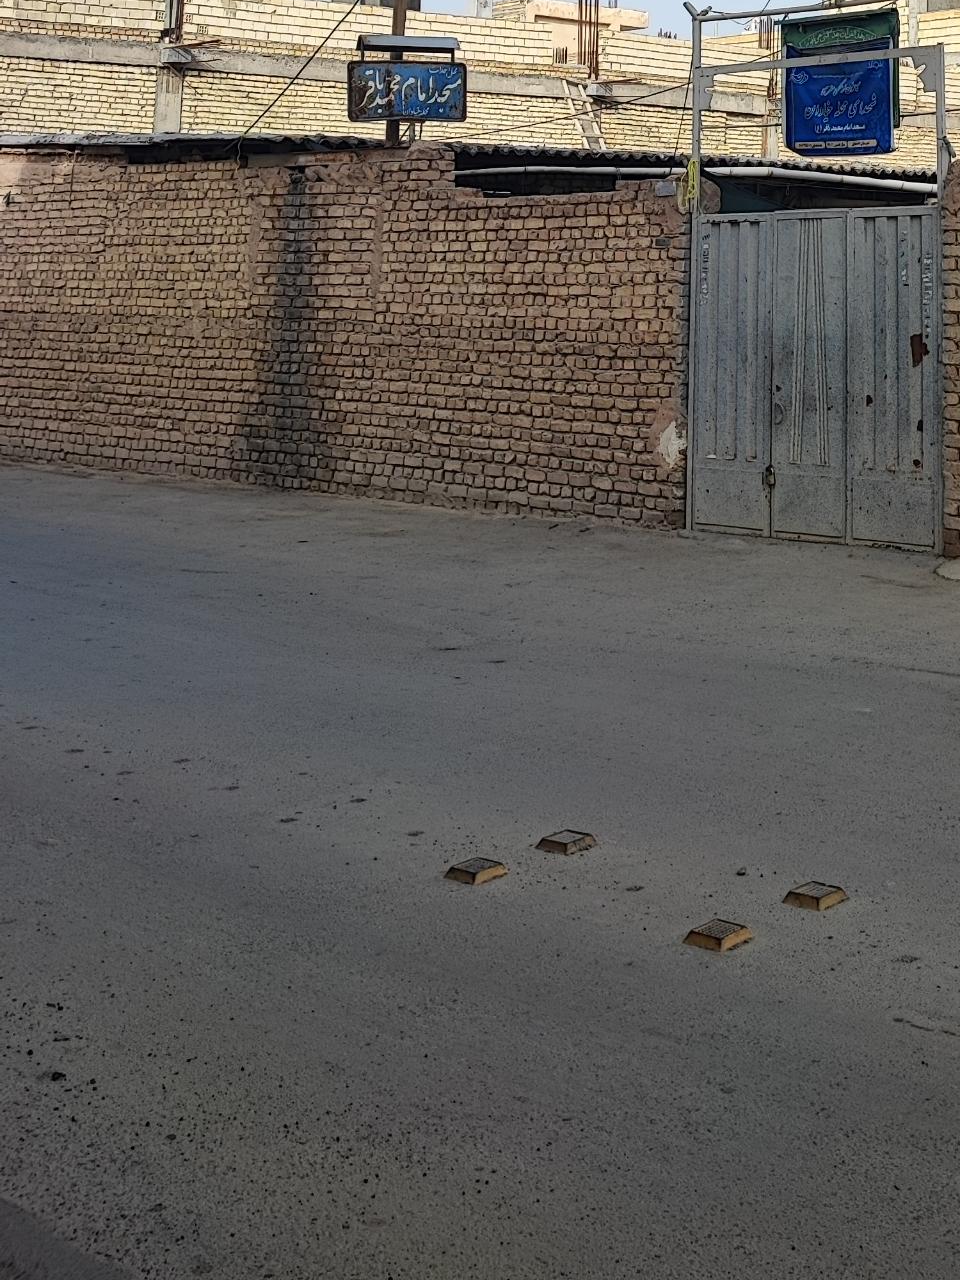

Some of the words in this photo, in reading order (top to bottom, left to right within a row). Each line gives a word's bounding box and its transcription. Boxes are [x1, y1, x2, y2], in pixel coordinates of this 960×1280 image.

[354, 69, 384, 111] باقر
[369, 74, 401, 108] محمد
[402, 76, 432, 106] امام
[427, 78, 462, 113] مسجد
